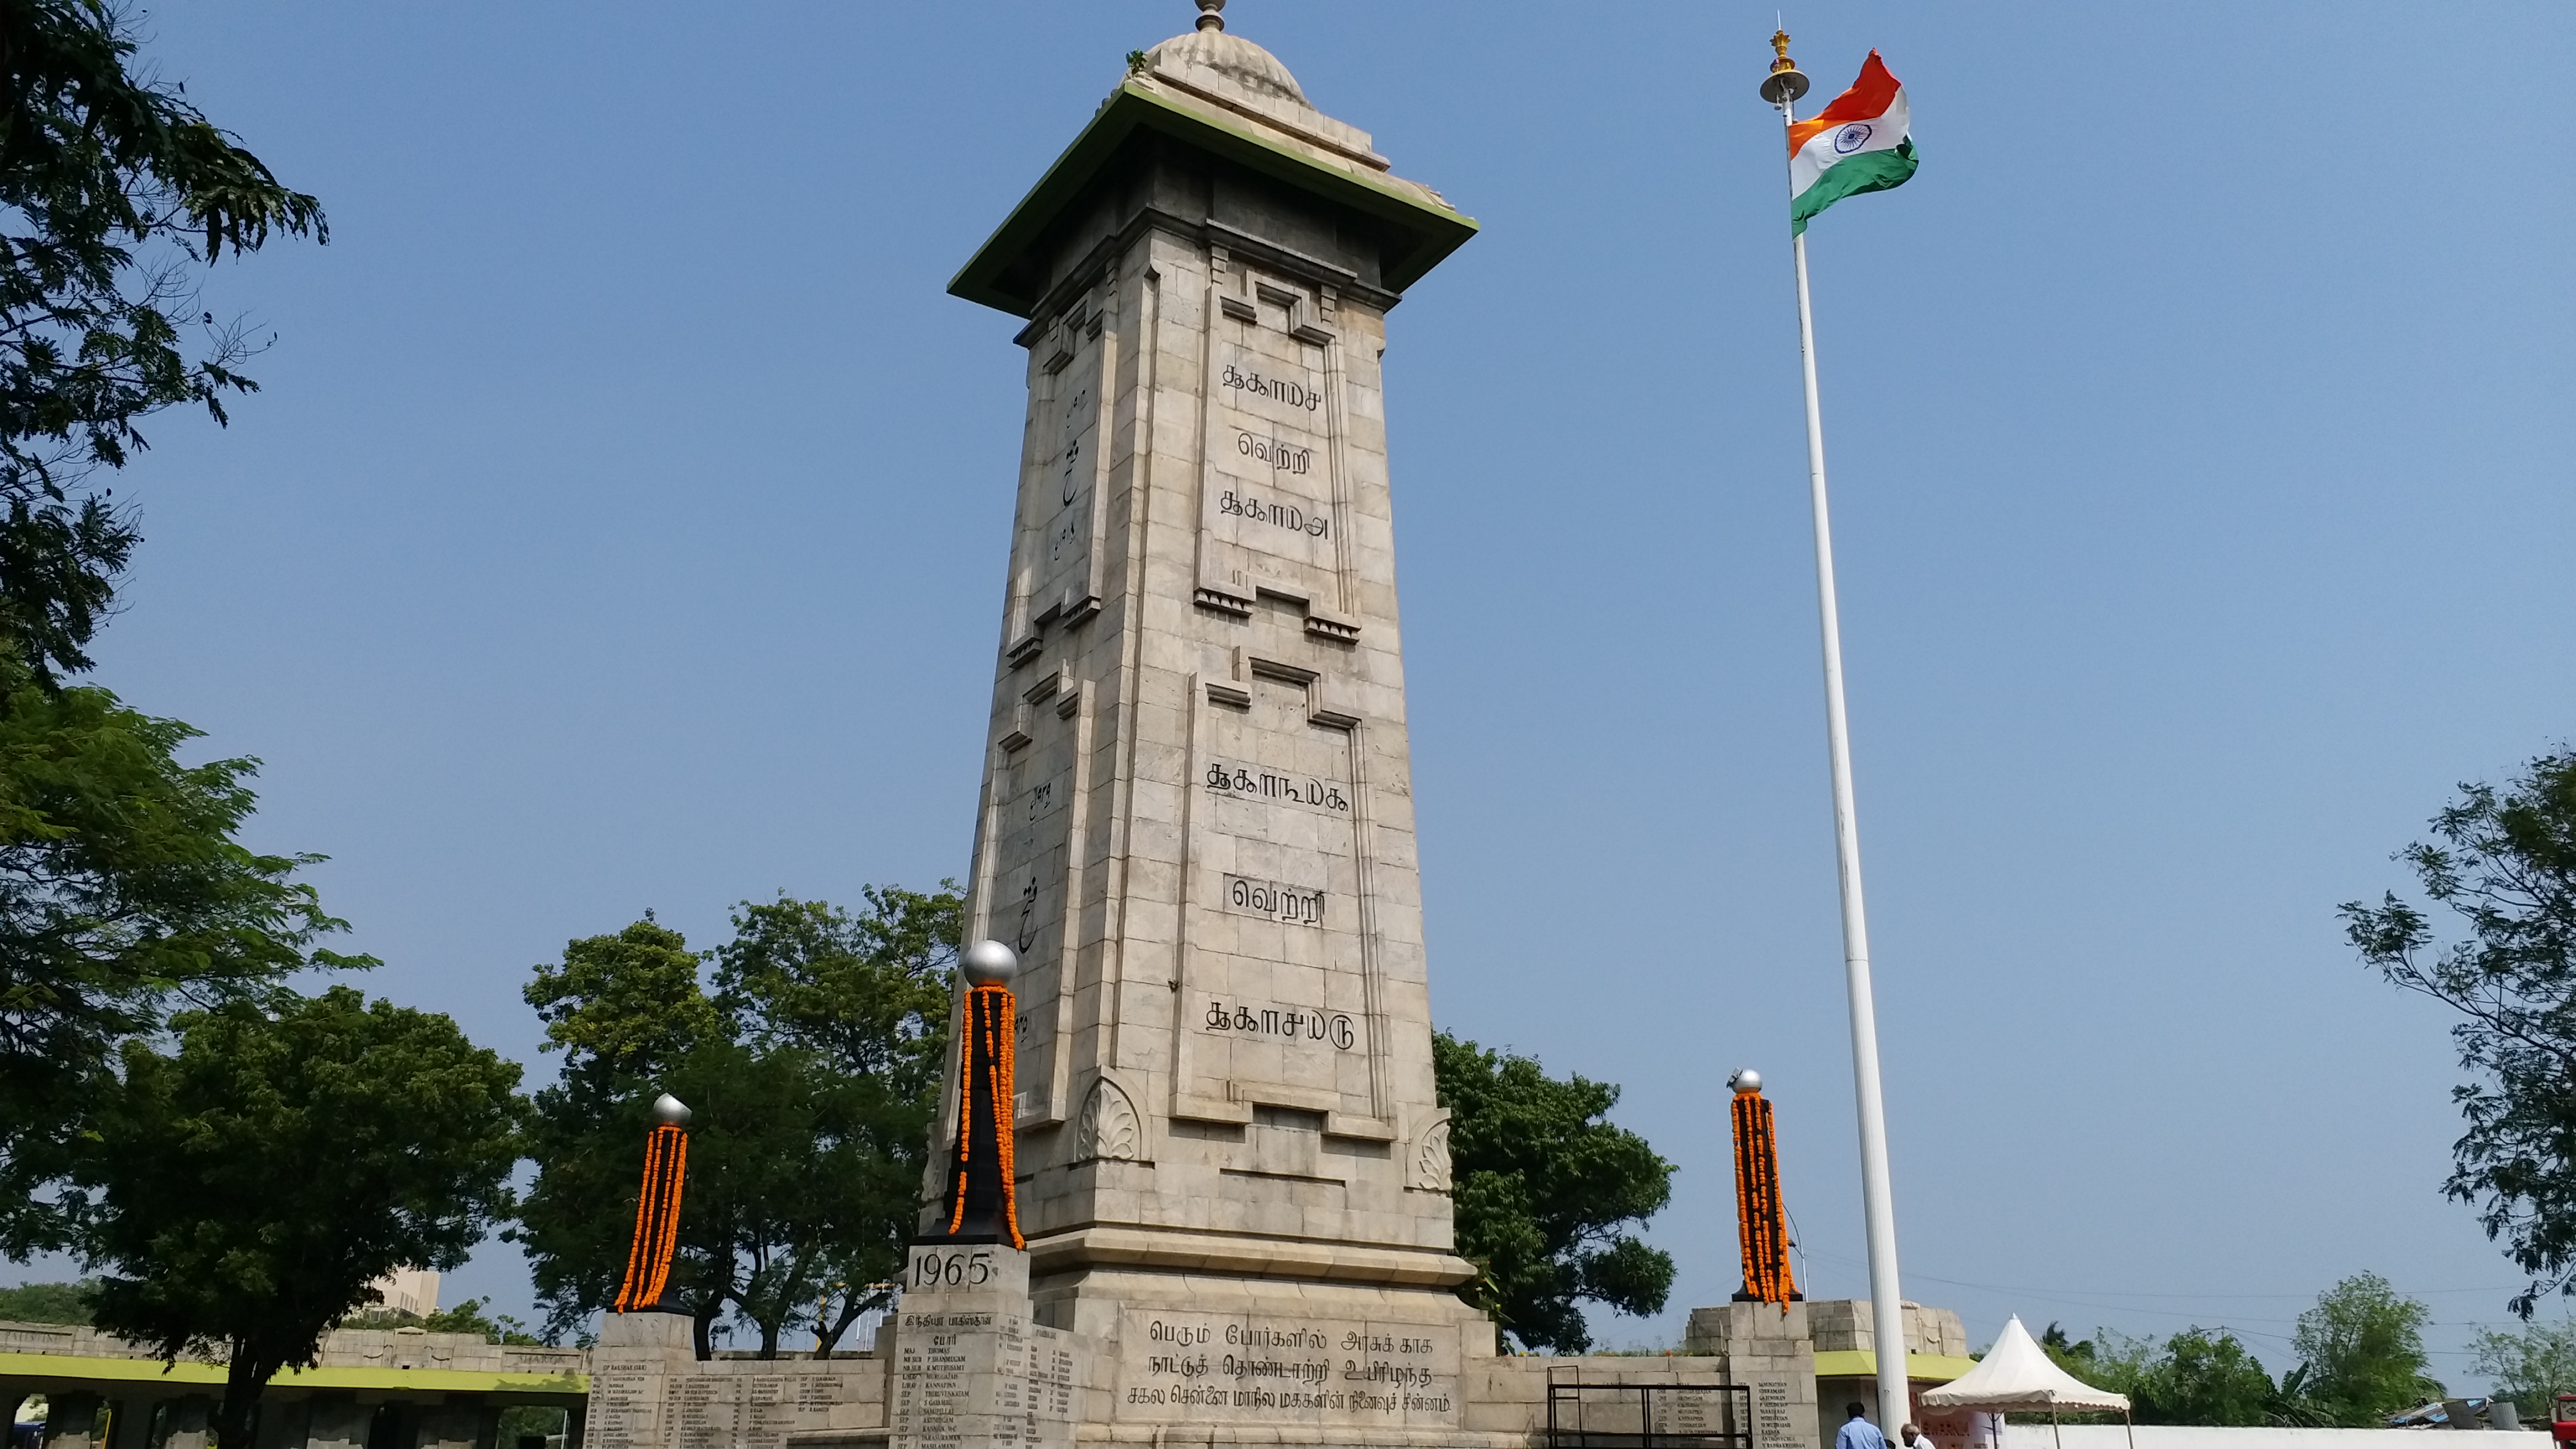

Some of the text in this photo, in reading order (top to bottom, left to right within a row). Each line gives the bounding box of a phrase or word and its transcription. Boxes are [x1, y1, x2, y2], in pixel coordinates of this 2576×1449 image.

[1238, 433, 1310, 475] வெற்றி
[1233, 880, 1324, 924] வெற்றி
[915, 1253, 989, 1287] 1965
[905, 1315, 944, 1328] இந்தியா
[1150, 1320, 1210, 1347] பெரும்
[1226, 1324, 1327, 1349] போர்களில்
[934, 1334, 956, 1346] போர்
[1148, 1353, 1208, 1378] நாட்டுத்
[1223, 1354, 1330, 1386] தொண்டாற்றி
[1128, 1387, 1166, 1405] சகல
[1171, 1384, 1228, 1405] சென்னை
[1233, 1386, 1275, 1410] மாநில
